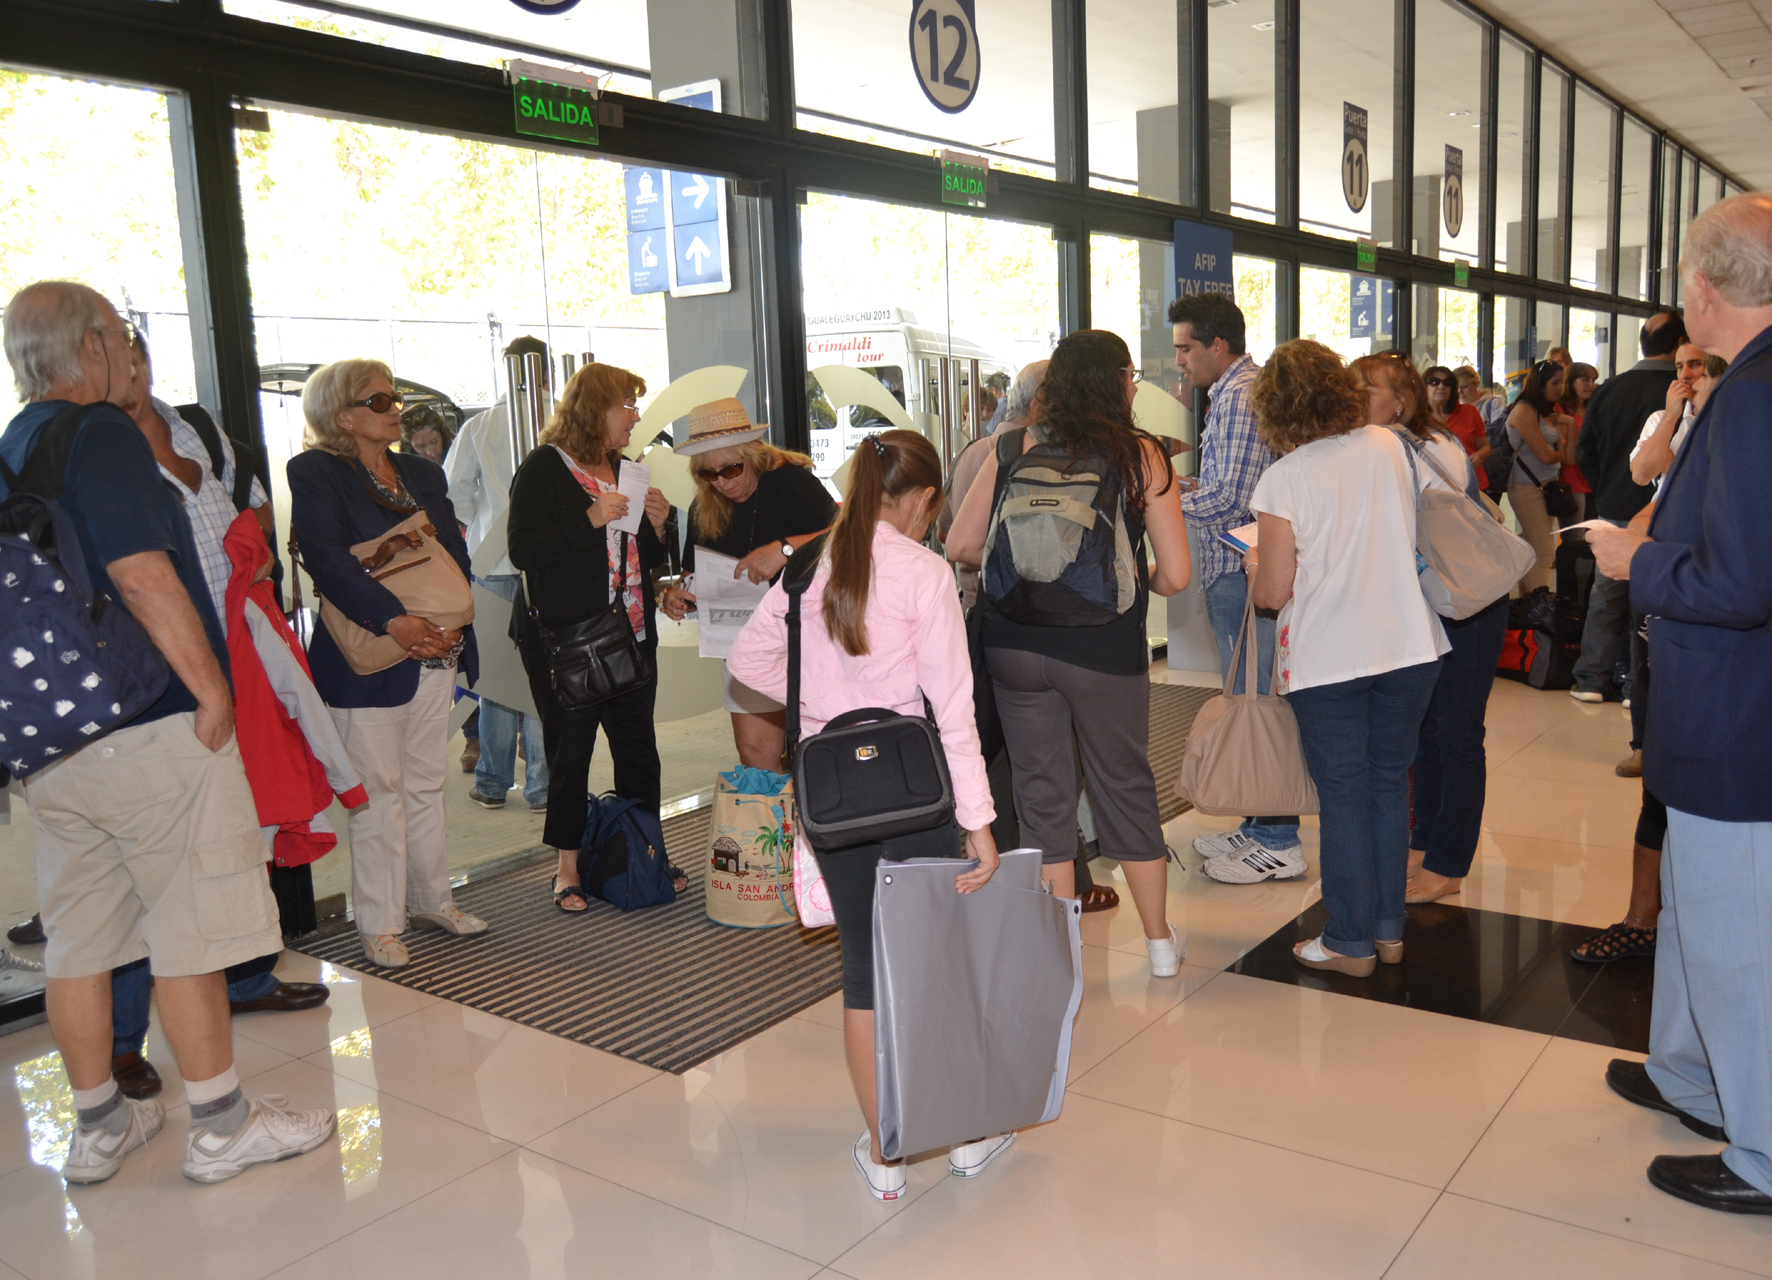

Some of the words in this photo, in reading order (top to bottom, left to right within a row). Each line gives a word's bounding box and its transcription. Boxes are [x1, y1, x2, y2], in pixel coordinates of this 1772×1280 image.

[918, 8, 970, 91] 12
[520, 95, 594, 128] SALIDA
[1344, 104, 1367, 128] Puerta
[1346, 150, 1363, 198] 11
[945, 175, 984, 195] SALIDA
[1447, 185, 1459, 226] 11
[1195, 253, 1216, 272] AFIP
[1358, 251, 1375, 264] SALIDA
[1178, 277, 1201, 298] TAX
[808, 311, 871, 325] GUALEGUAYCHU
[873, 309, 891, 321] 2013
[807, 336, 872, 353] Crimaldi
[857, 352, 884, 363] tour
[711, 879, 732, 891] ISLA
[738, 884, 760, 893] SAN
[737, 893, 779, 901] COLOMBIA
